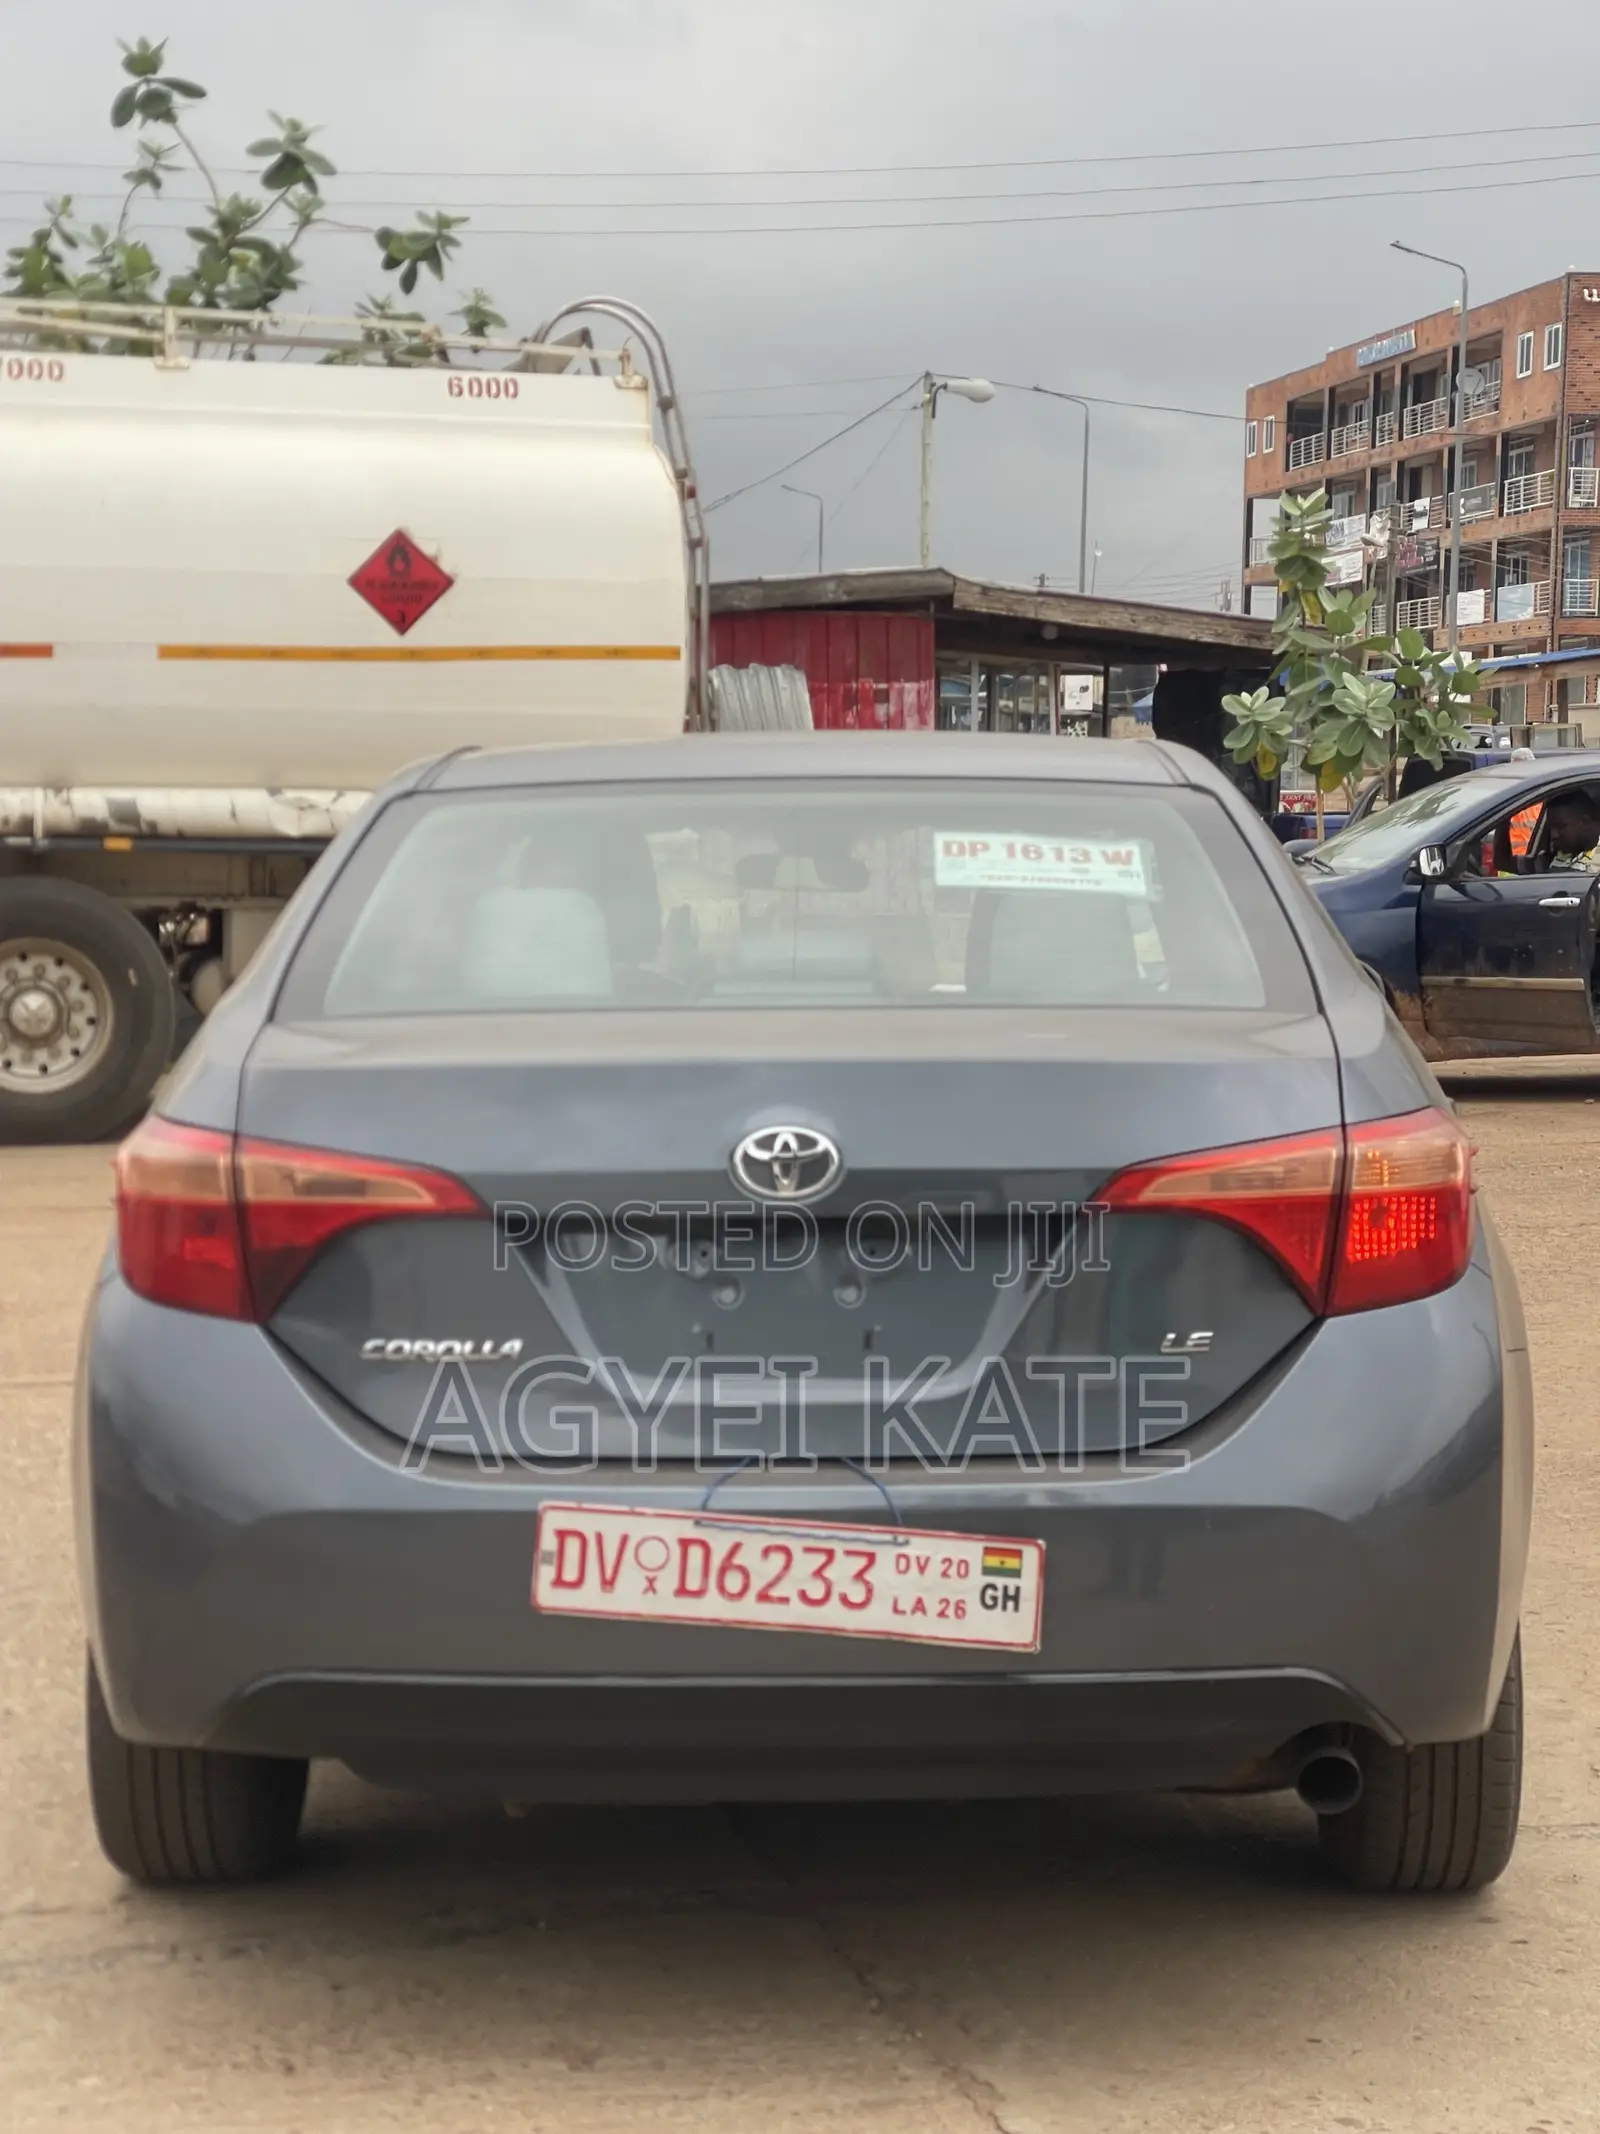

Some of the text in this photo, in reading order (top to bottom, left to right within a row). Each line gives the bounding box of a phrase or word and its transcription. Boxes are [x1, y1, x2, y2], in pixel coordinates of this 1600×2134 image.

[0, 356, 64, 381] 000
[447, 375, 519, 399] 6000
[942, 839, 1135, 867] DP 1613 W
[359, 1337, 525, 1363] COROLLA
[1160, 1331, 1215, 1353] LE
[673, 1537, 877, 1611] D6233
[895, 1553, 970, 1580] DV 20
[892, 1596, 968, 1620] LA 26
[979, 1582, 1022, 1614] GH
